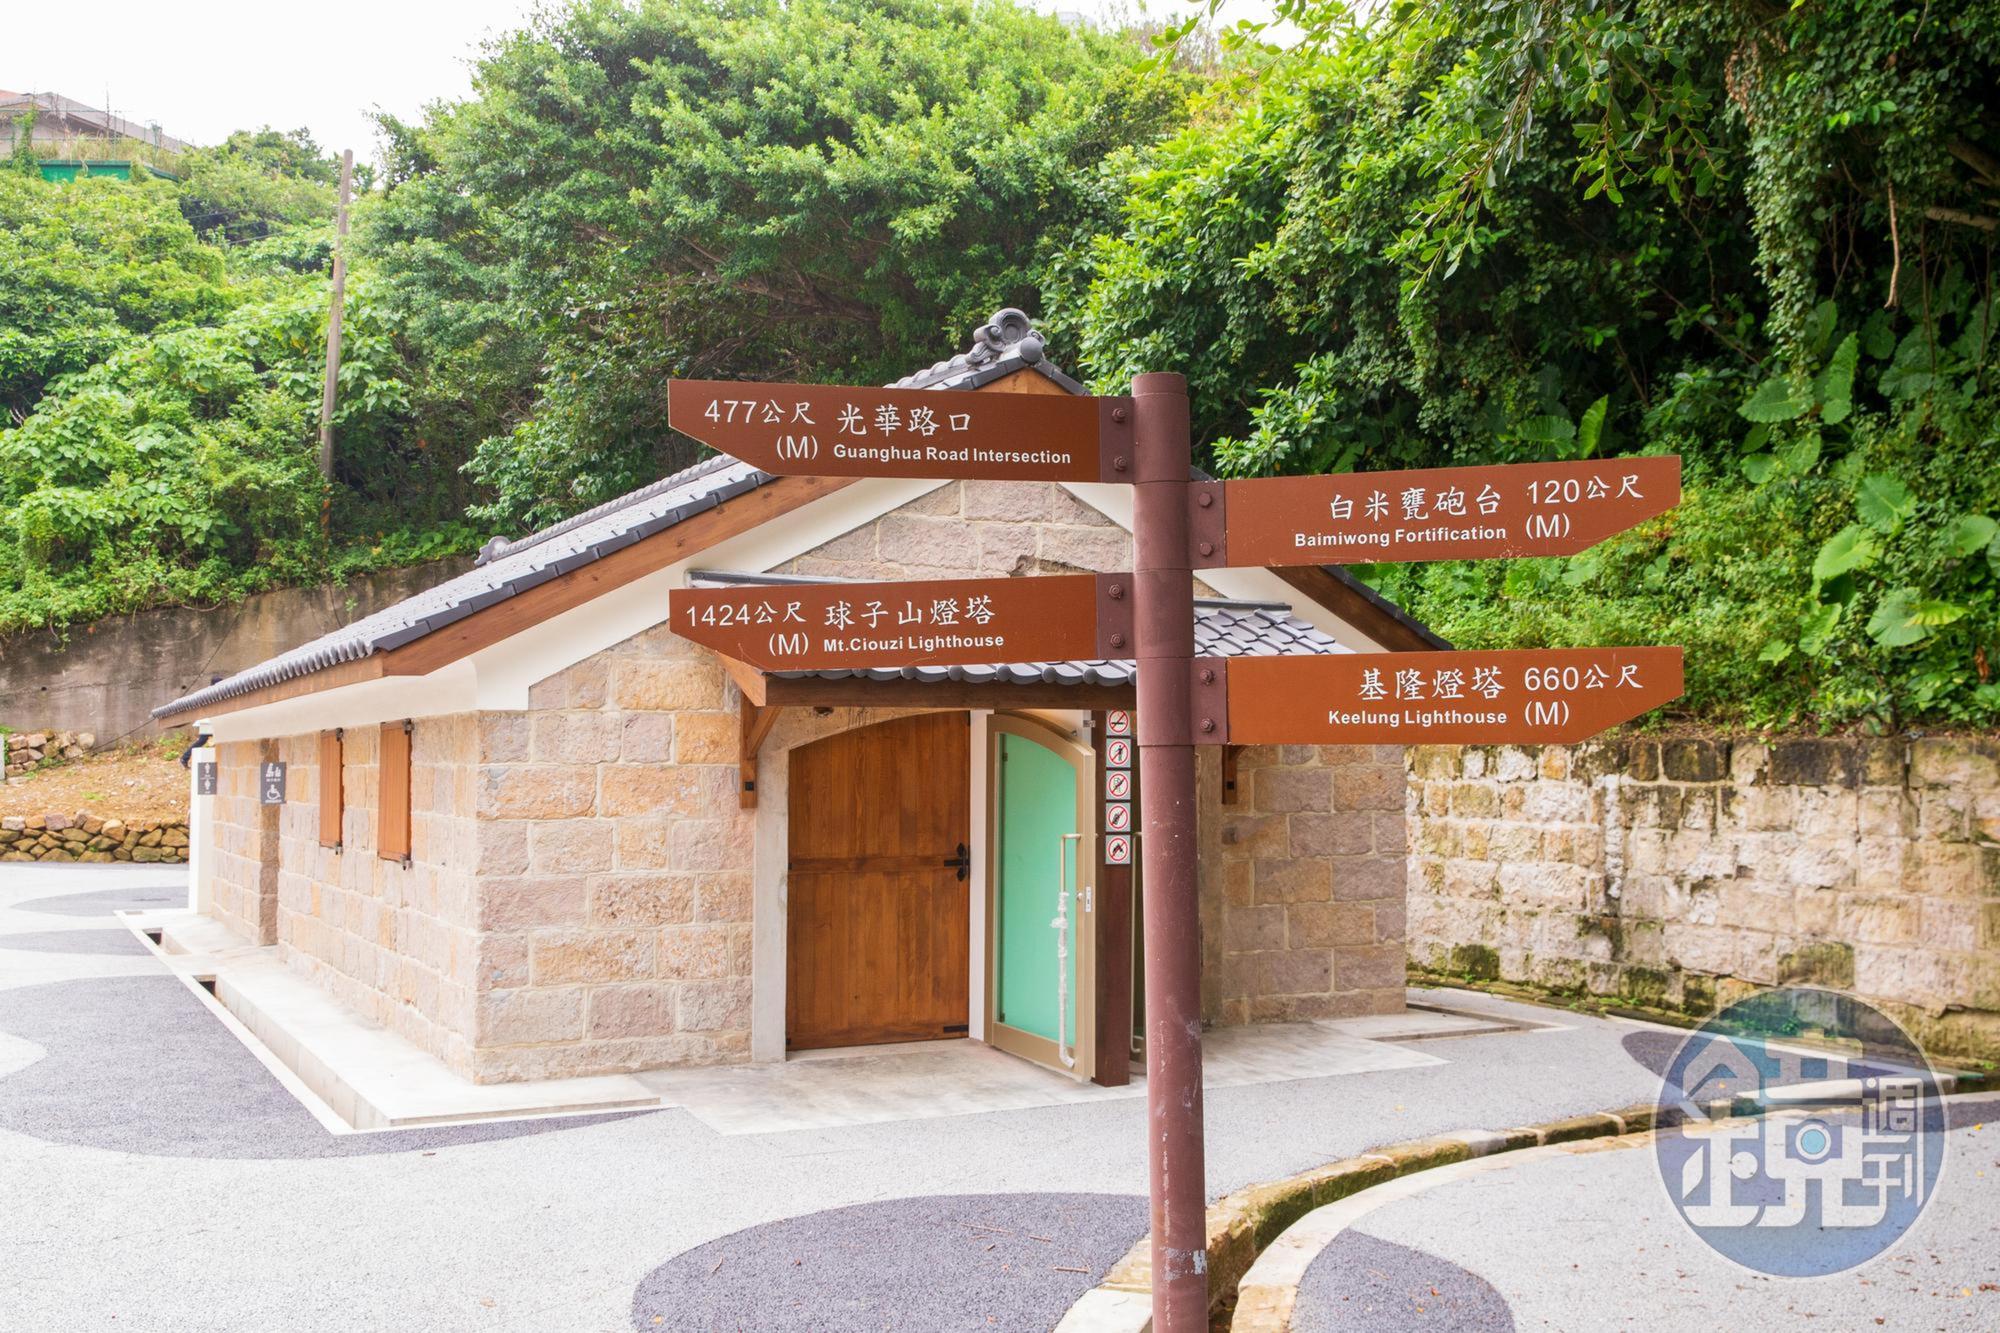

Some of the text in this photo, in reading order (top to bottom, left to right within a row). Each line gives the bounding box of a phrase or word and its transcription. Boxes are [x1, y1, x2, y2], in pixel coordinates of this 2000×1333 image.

[704, 399, 971, 437] 477公尺 光華路口
[776, 435, 1071, 465] (M) Guanghua Road Intersection
[1330, 474, 1644, 522] 白米甕砲台 120公尺
[1295, 512, 1571, 549] Baimiwong Fortification (M)
[686, 594, 995, 631] 1424公尺 球子山燈塔
[768, 632, 809, 657] (M)
[908, 634, 1004, 652] Lighthouse
[1358, 663, 1644, 701] 基隆燈塔 660公尺
[1328, 700, 1571, 728] Keelung Lighthouse (M)
